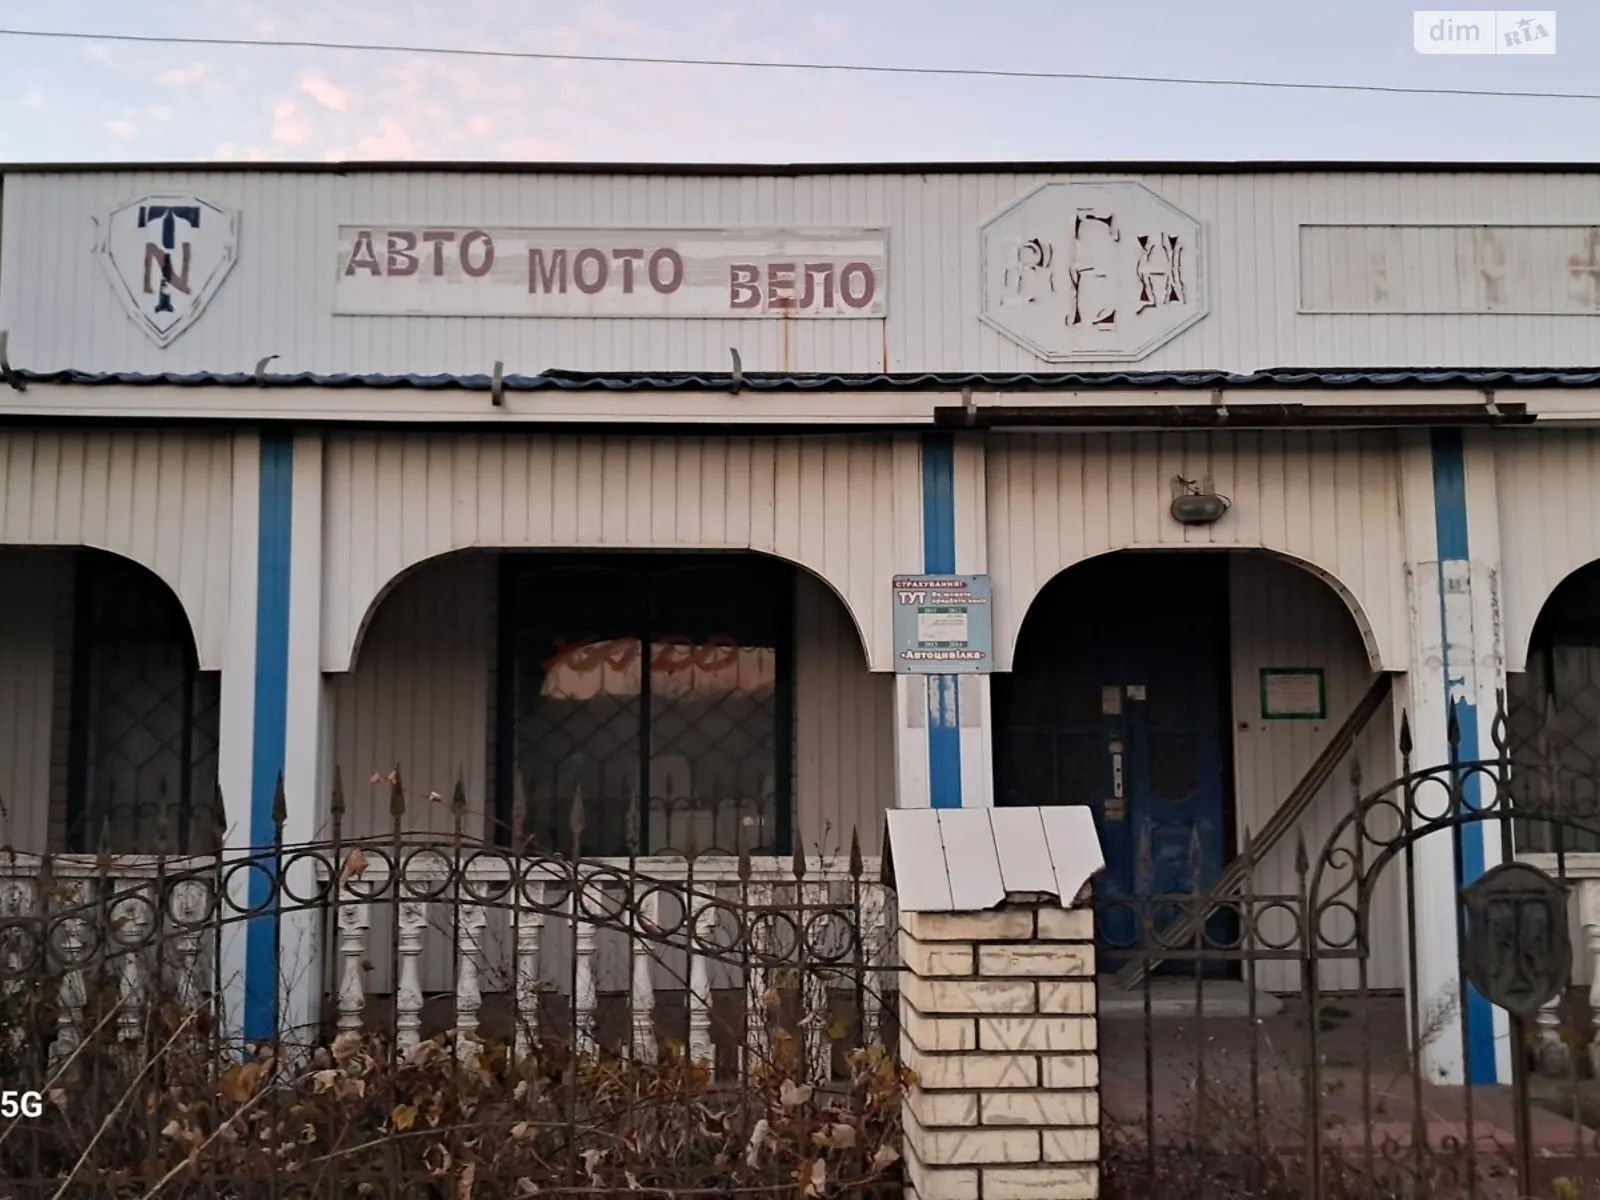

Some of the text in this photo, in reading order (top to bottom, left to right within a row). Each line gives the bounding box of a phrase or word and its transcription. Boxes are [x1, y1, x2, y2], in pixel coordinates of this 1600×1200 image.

[345, 230, 876, 309] АВТО МОТО ВЕЛО
[899, 592, 926, 605] ТУТ
